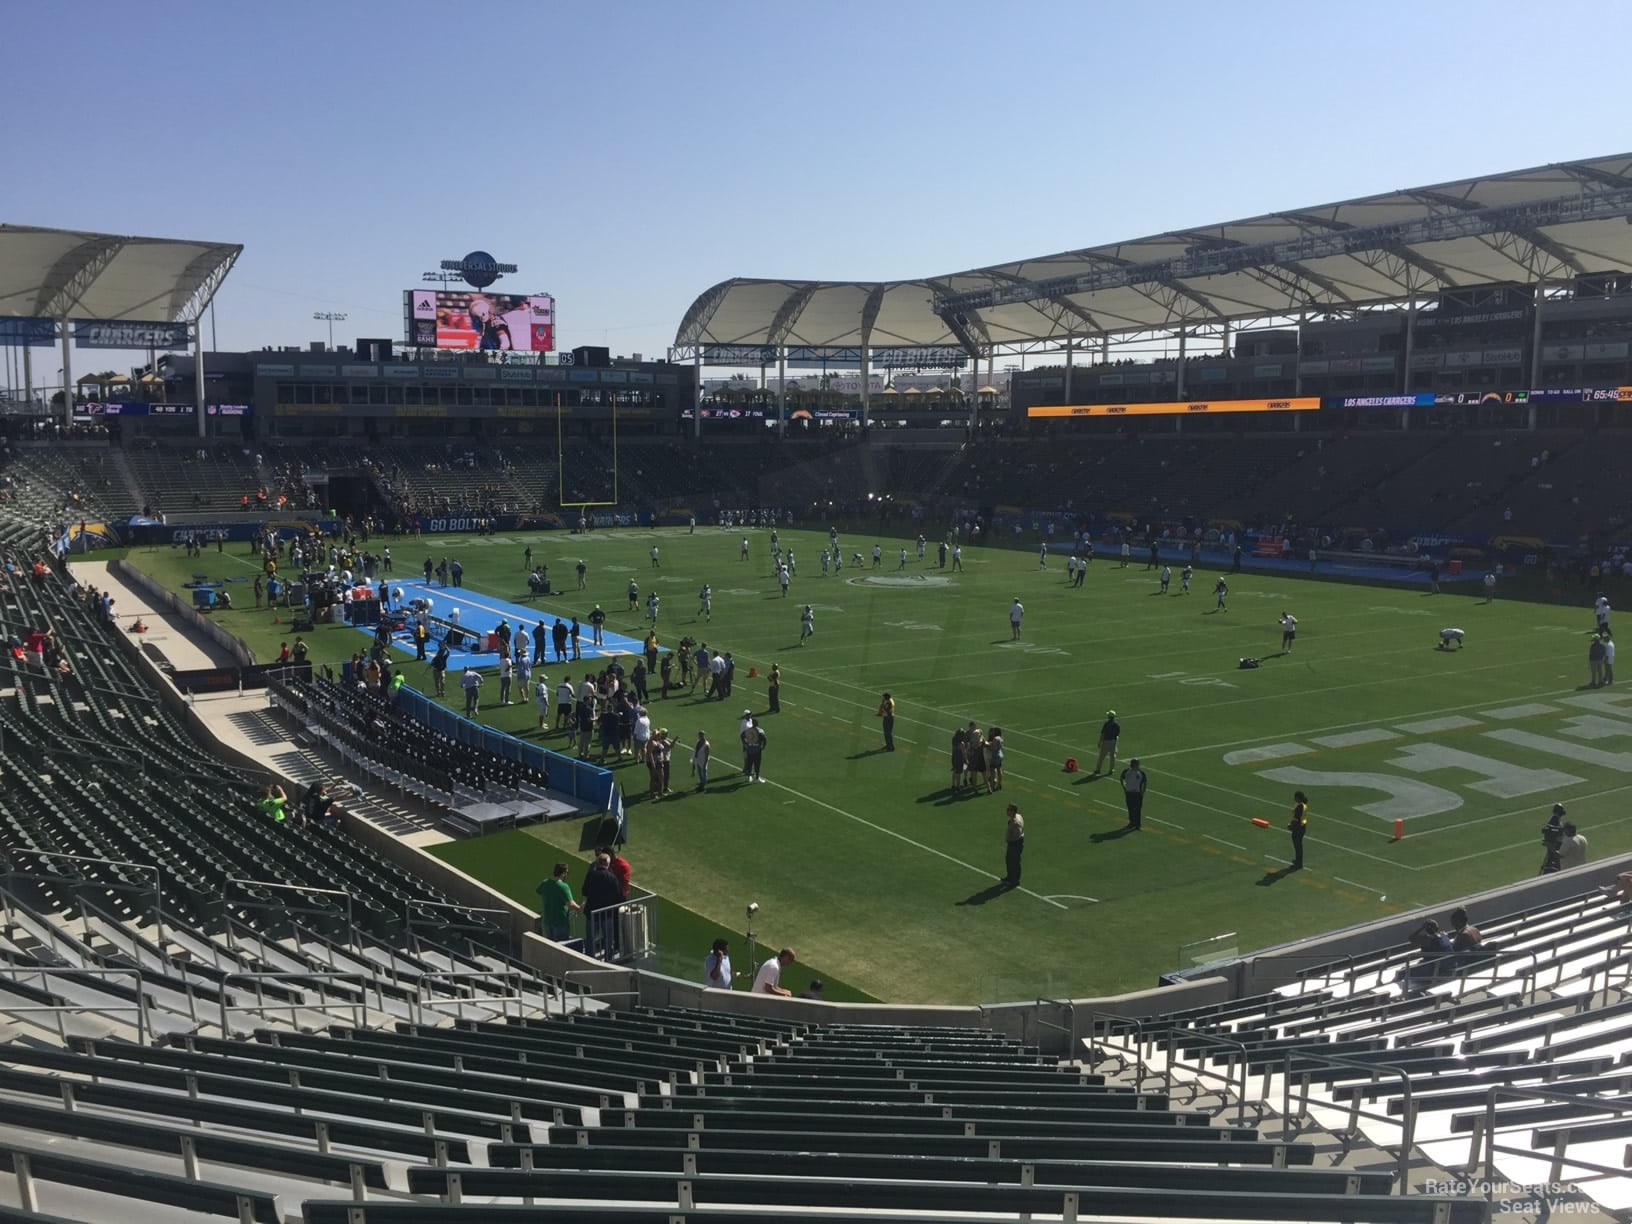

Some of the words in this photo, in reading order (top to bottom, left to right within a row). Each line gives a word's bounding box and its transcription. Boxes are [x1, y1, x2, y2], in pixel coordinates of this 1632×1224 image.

[440, 259, 487, 272] UNIVERSAL
[488, 262, 518, 273] STUDIOS
[89, 327, 174, 346] CHARGERS
[845, 381, 881, 390] TOYTA
[1344, 397, 1356, 406] LOS
[1356, 397, 1383, 406] ANGELES
[1383, 396, 1416, 405] CHARGERS
[1458, 394, 1464, 403] 0
[1505, 393, 1512, 402] 0
[430, 519, 447, 532] GO
